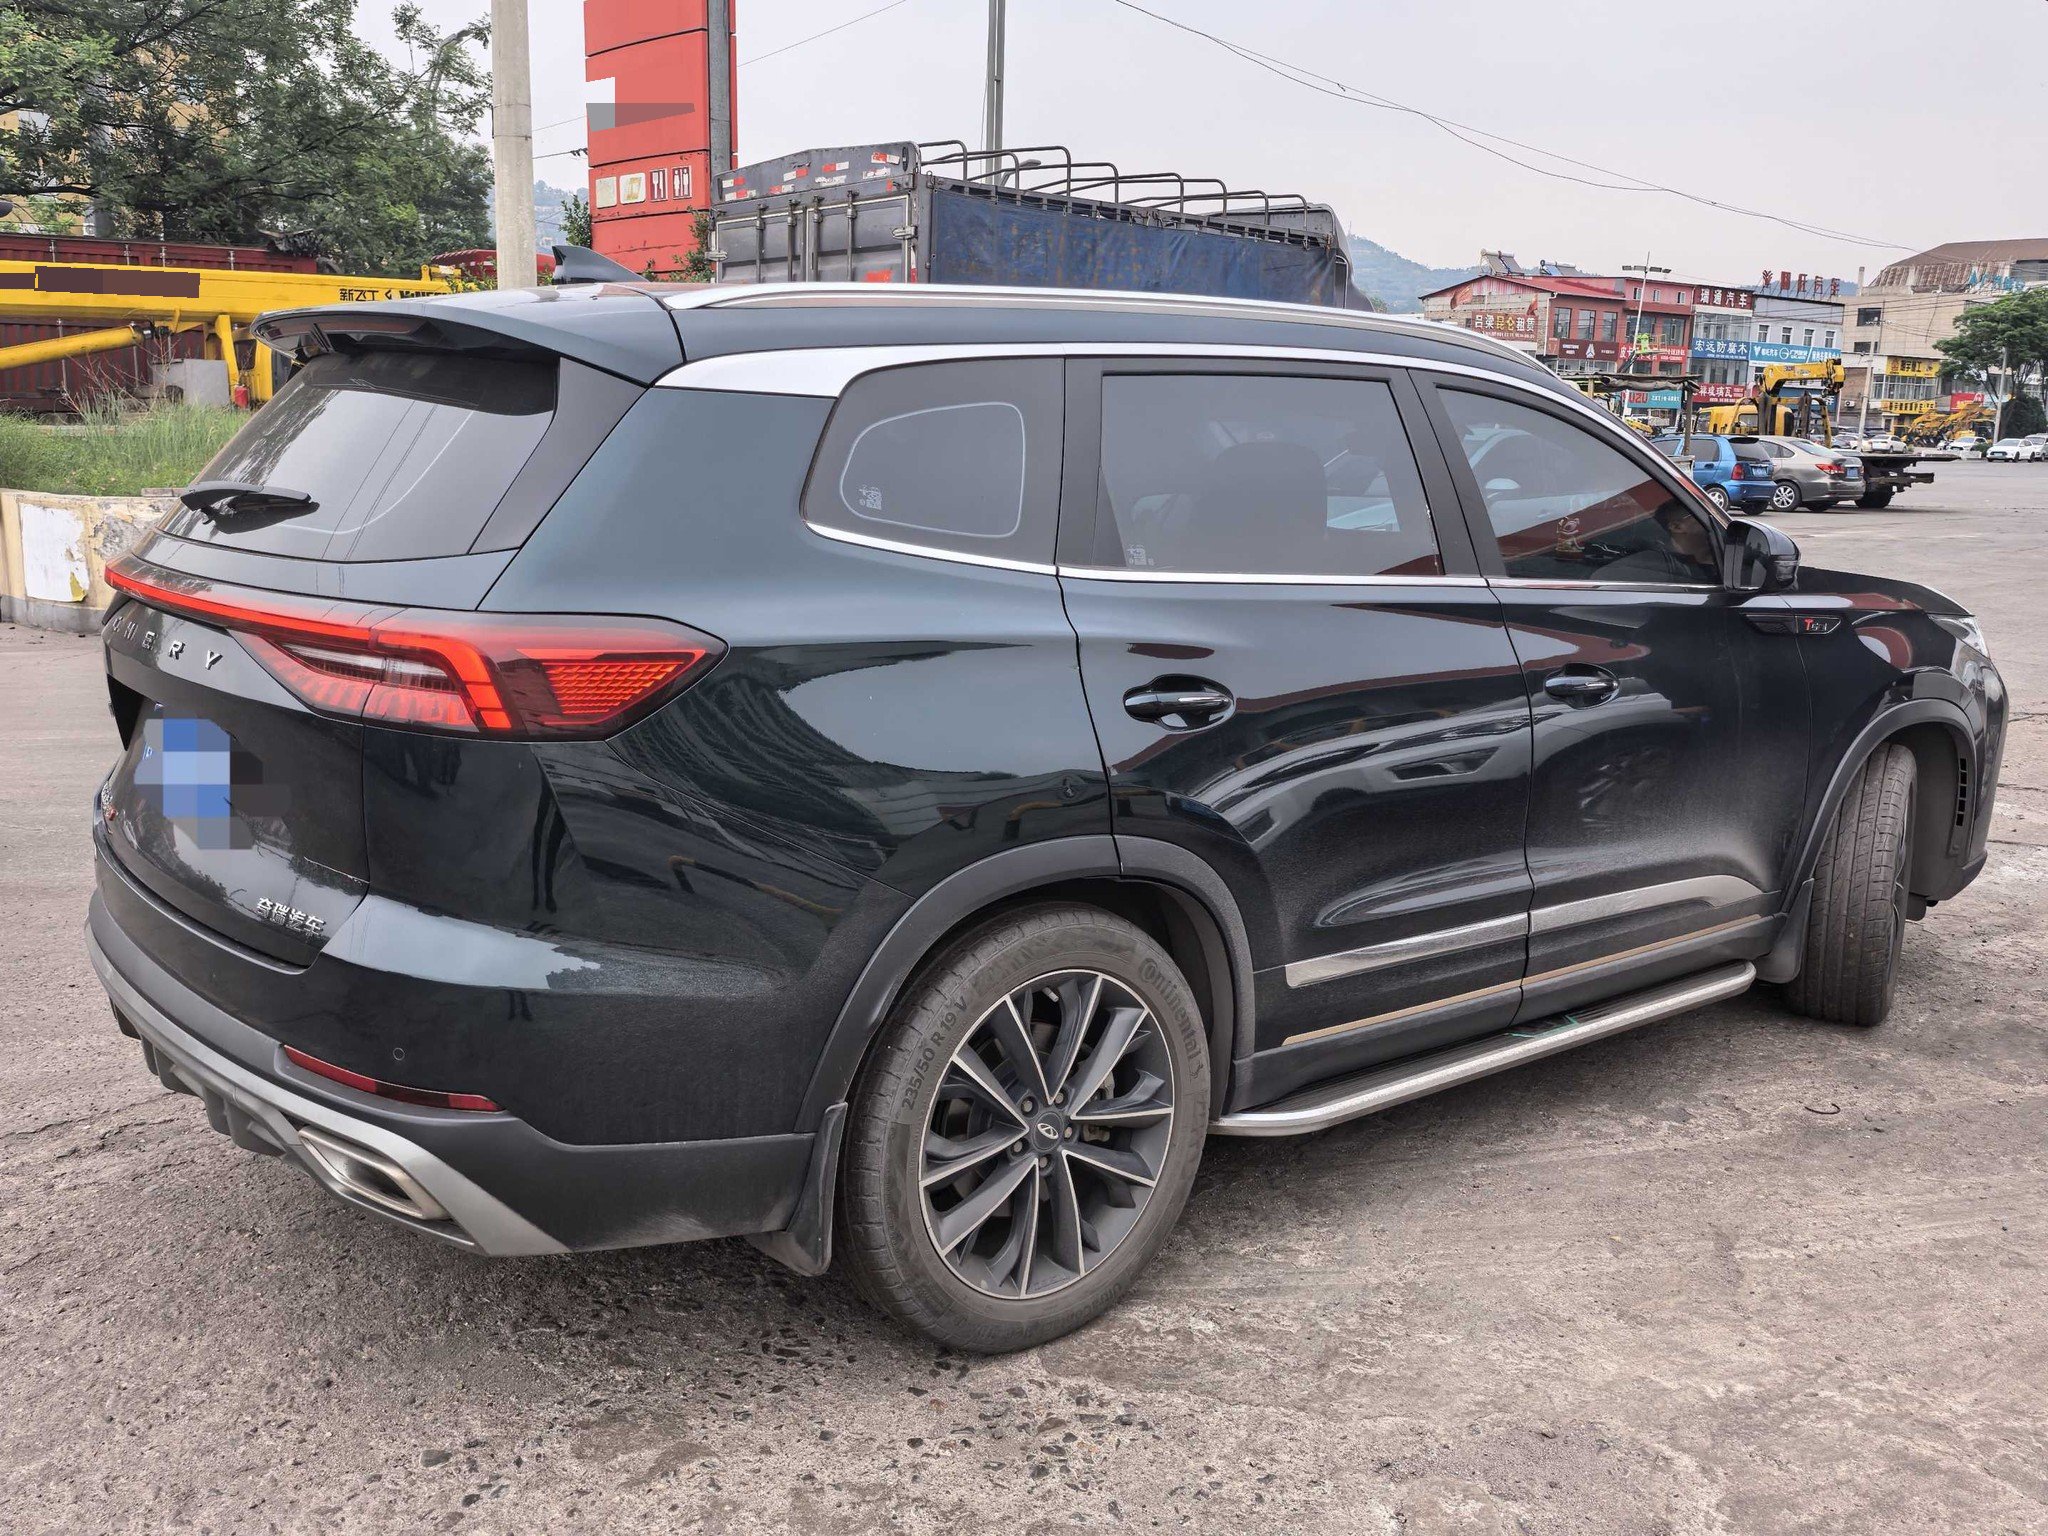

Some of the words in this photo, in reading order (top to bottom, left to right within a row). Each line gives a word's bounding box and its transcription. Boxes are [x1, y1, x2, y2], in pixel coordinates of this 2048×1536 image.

[1475, 314, 1536, 332] 吕梁昆仑租赁
[1692, 384, 1732, 398] 祥琉璃瓦
[257, 896, 326, 936] 奇瑞汽车
[1137, 956, 1203, 1062] Continental
[901, 1047, 936, 1111] 235/50
